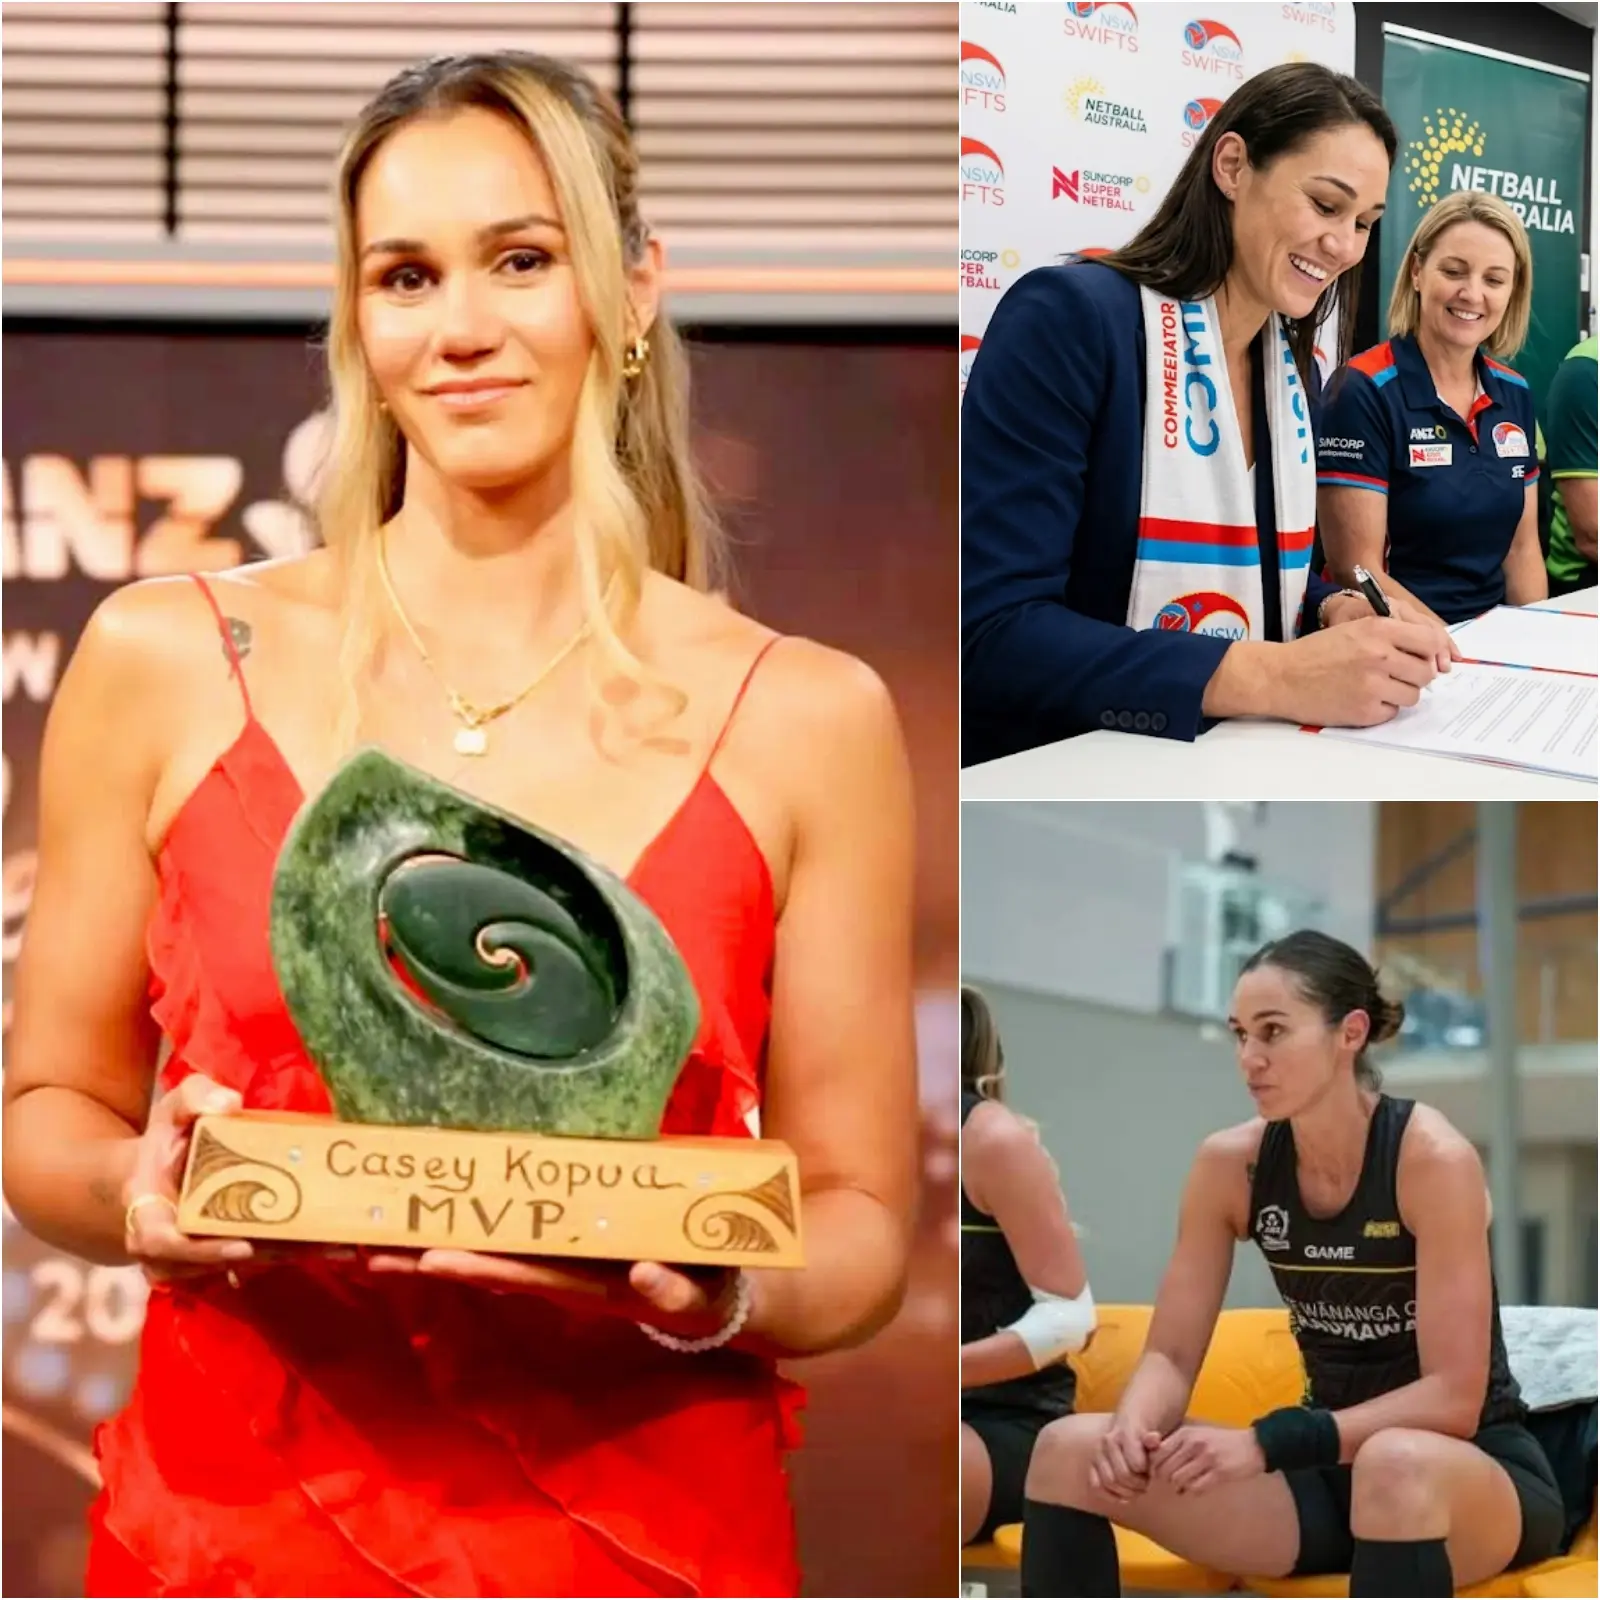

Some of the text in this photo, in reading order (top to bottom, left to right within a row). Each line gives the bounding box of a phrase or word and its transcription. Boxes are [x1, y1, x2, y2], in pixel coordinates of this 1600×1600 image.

[974, 2, 1017, 14] RALIA
[1101, 13, 1135, 33] NSW
[1281, 4, 1336, 34] SWIFTS
[1064, 18, 1139, 53] SWIFTS
[1182, 50, 1244, 80] SWIFTS
[961, 70, 1001, 90] NSW
[961, 87, 1007, 112] FTS
[1085, 98, 1145, 121] NETBALL
[1084, 113, 1147, 133] AUSTRALIA
[1083, 170, 1134, 187] SUNCORP
[1450, 163, 1562, 206] NETBALL
[1083, 183, 1121, 197] SUPER
[1083, 196, 1135, 212] NETBALL
[326, 1139, 686, 1197] Casey Kopua
[407, 1194, 581, 1244] MVP.
[1304, 1245, 1356, 1260] GAME
